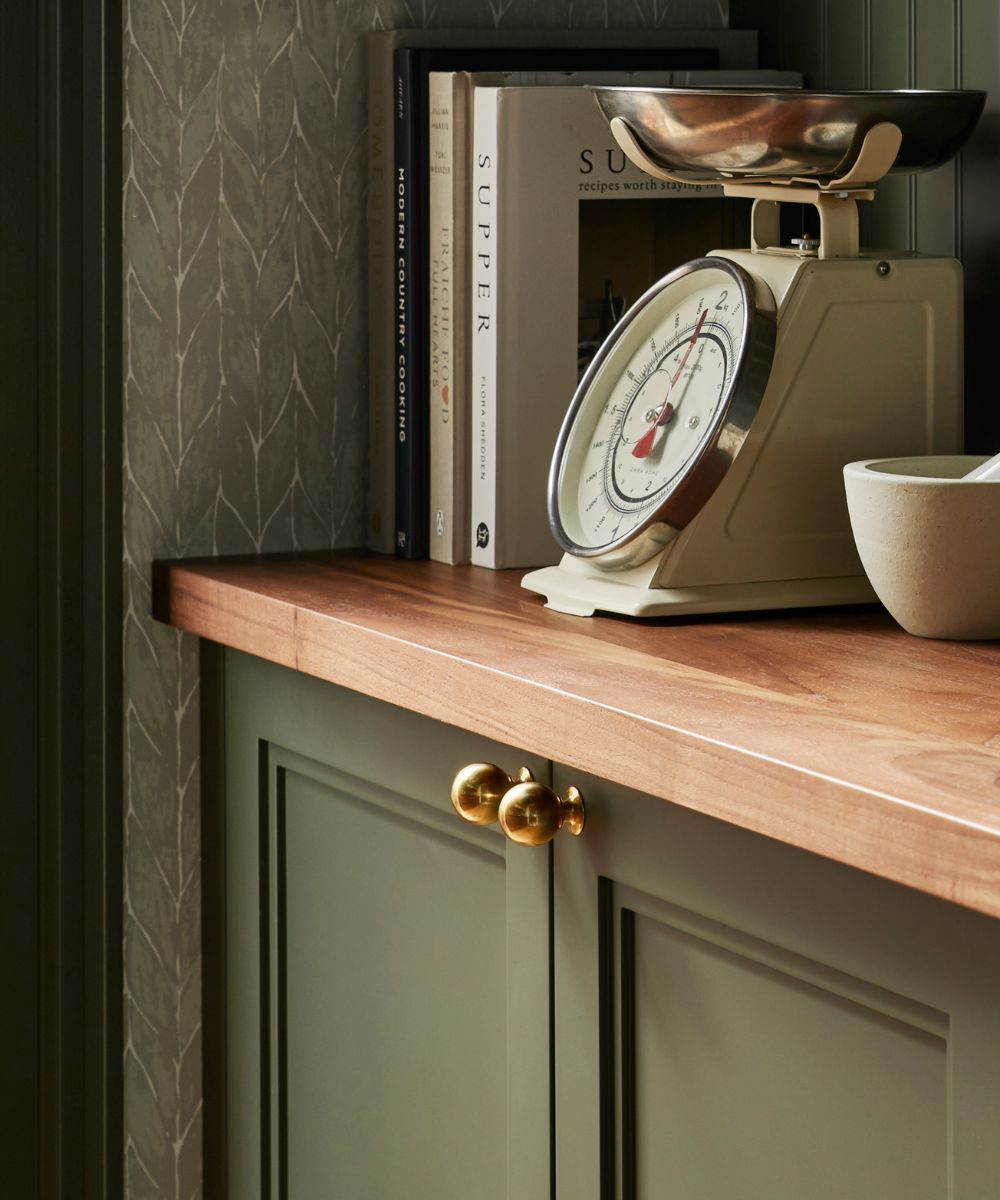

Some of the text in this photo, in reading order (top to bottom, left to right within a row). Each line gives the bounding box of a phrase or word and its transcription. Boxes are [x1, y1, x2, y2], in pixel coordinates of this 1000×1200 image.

[579, 180, 620, 193] recipes
[623, 180, 657, 190] worth
[478, 154, 490, 334] SUPPER
[714, 290, 728, 310] 2
[644, 481, 652, 491] 2
